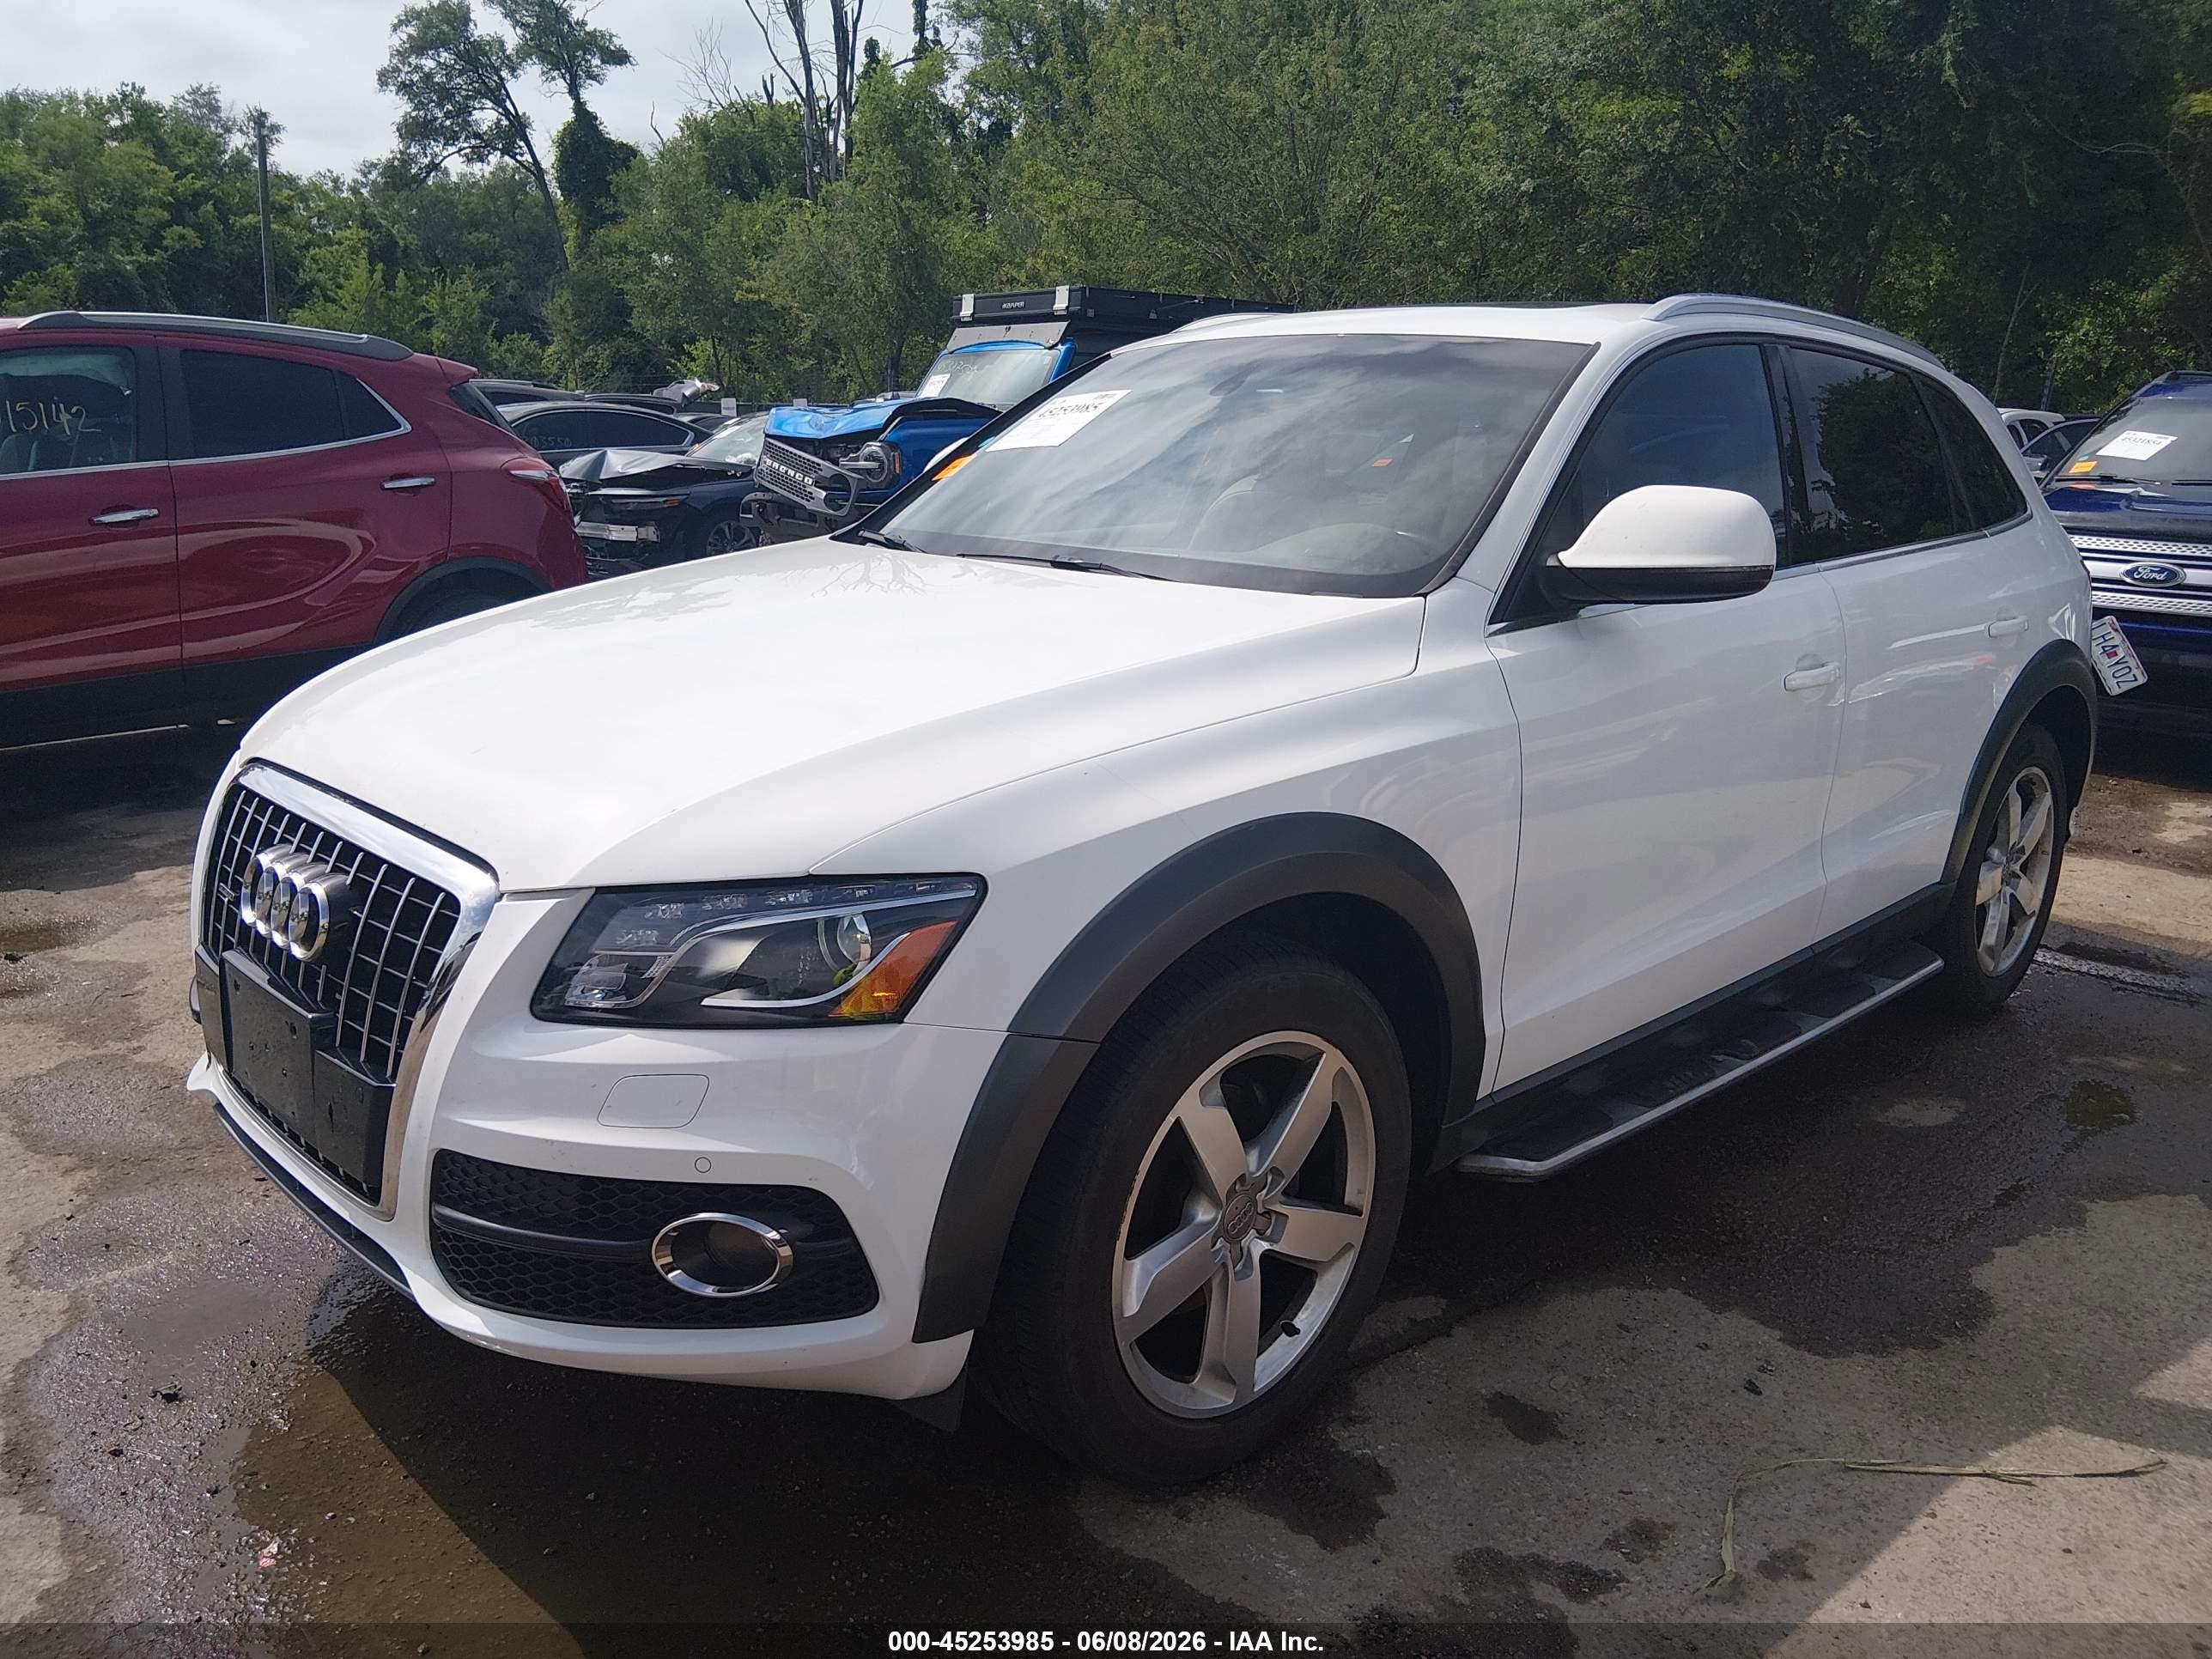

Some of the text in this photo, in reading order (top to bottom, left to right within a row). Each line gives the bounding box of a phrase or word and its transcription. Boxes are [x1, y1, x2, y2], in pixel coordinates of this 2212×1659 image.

[0, 399, 101, 435] 15142
[765, 458, 813, 485] BRONCO
[2133, 566, 2169, 580] Ford
